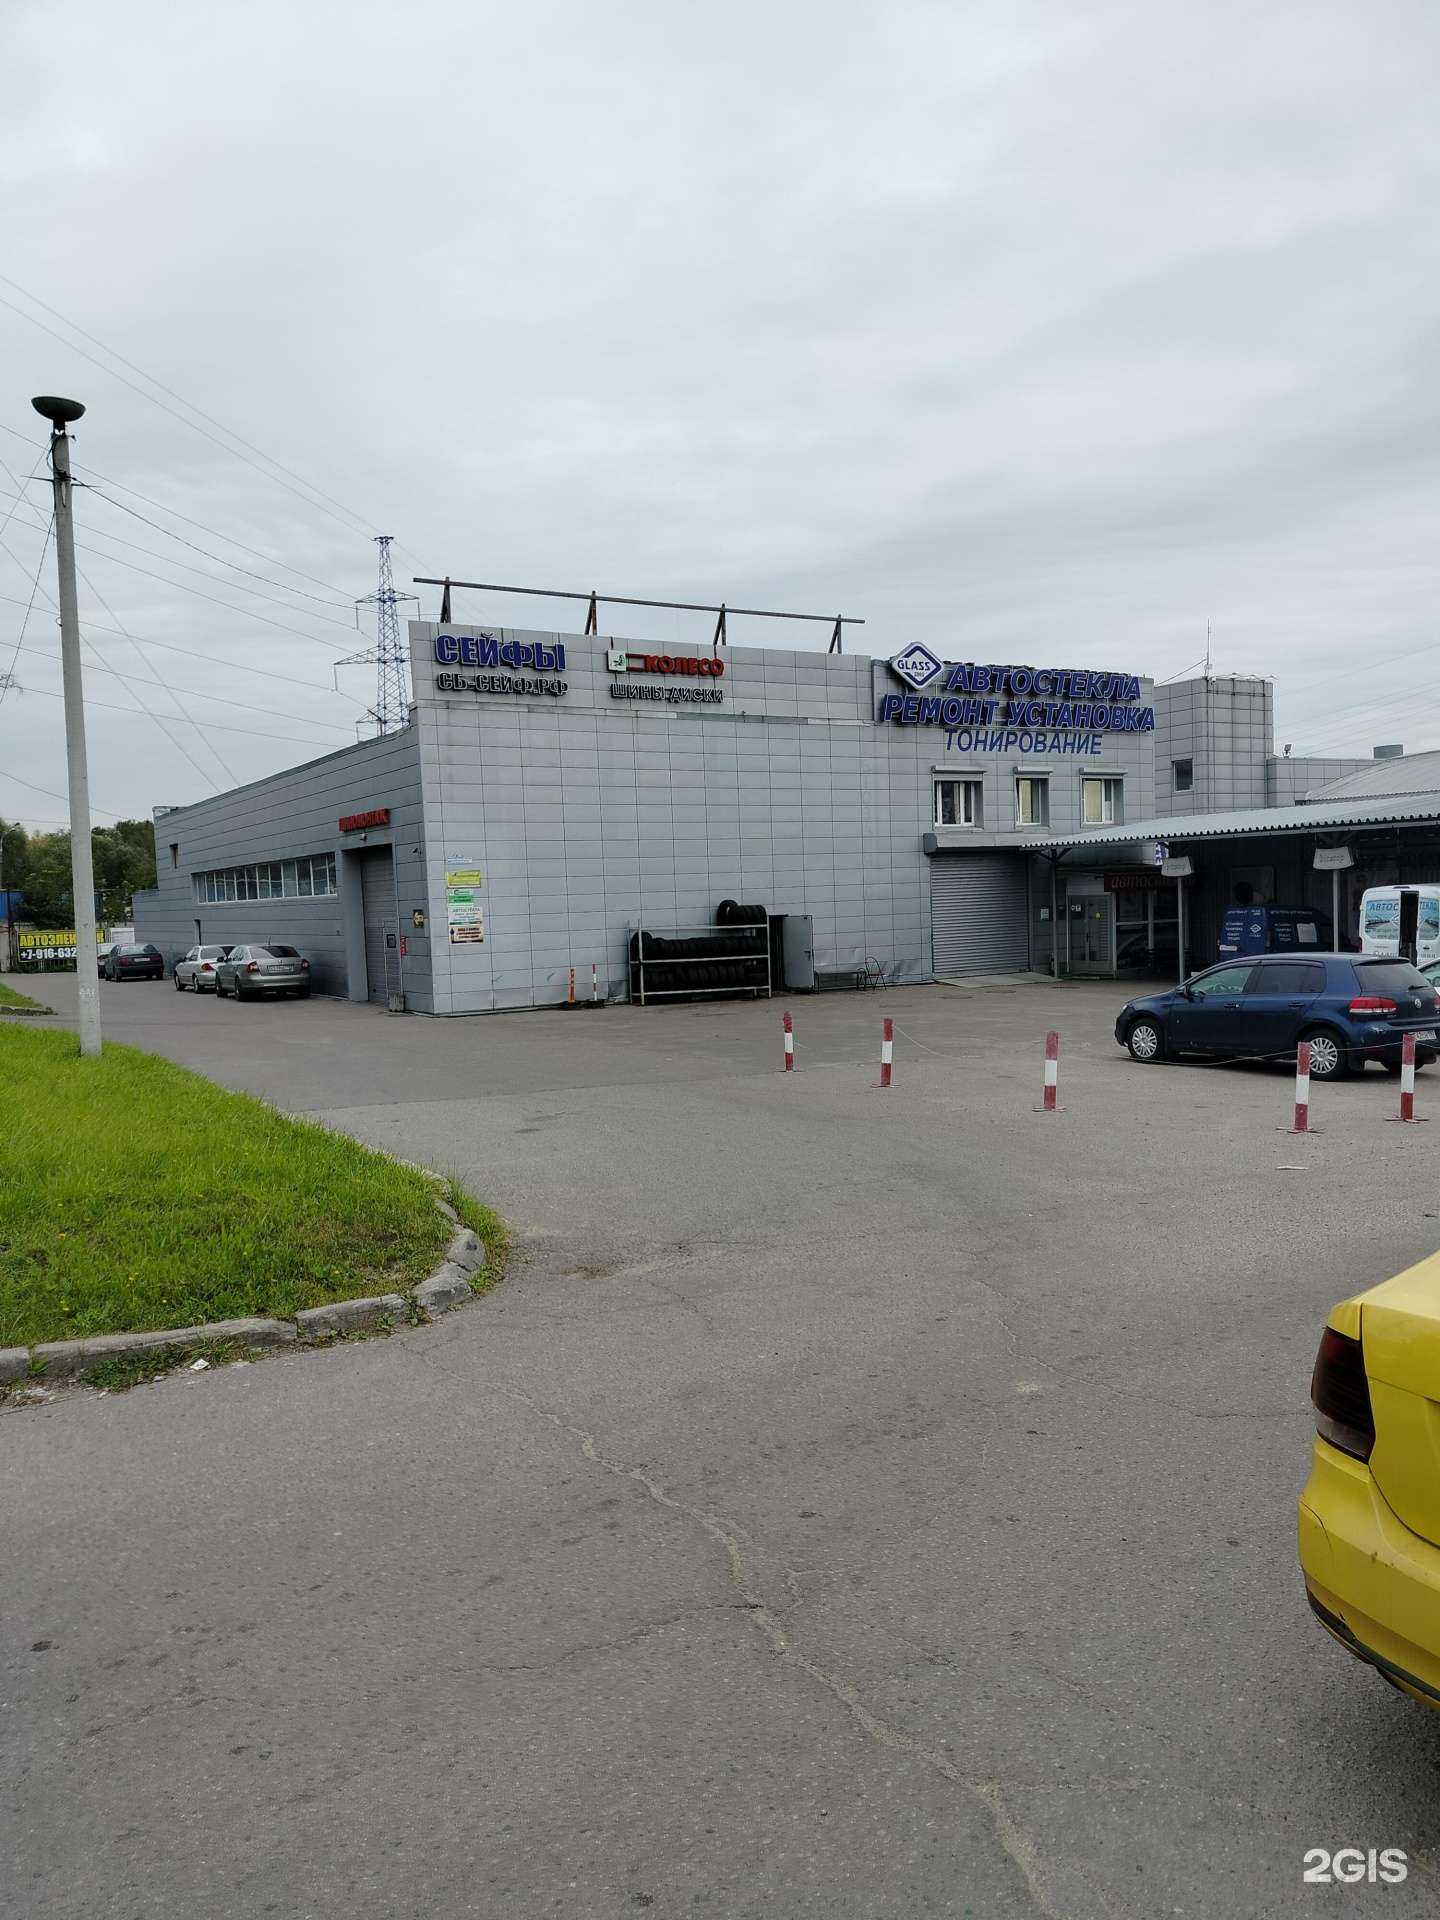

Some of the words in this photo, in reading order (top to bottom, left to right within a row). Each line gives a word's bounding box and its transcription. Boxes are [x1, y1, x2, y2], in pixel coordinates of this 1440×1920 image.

[435, 632, 566, 671] СЕЙФЫ
[644, 655, 724, 676] КОЛЕСО
[897, 659, 931, 671] GLASS
[438, 671, 568, 696] СБ-СЕЙФ.РФ
[611, 683, 665, 700] ШИНЫ
[670, 686, 724, 703] ДИСКИ
[947, 664, 1141, 701] АВТОСТЕКЛА
[882, 694, 1000, 726] РЕМОНТ
[1008, 701, 1155, 731] УСТАНОВКА
[945, 728, 1103, 755] ТОНИРОВАНИЕ
